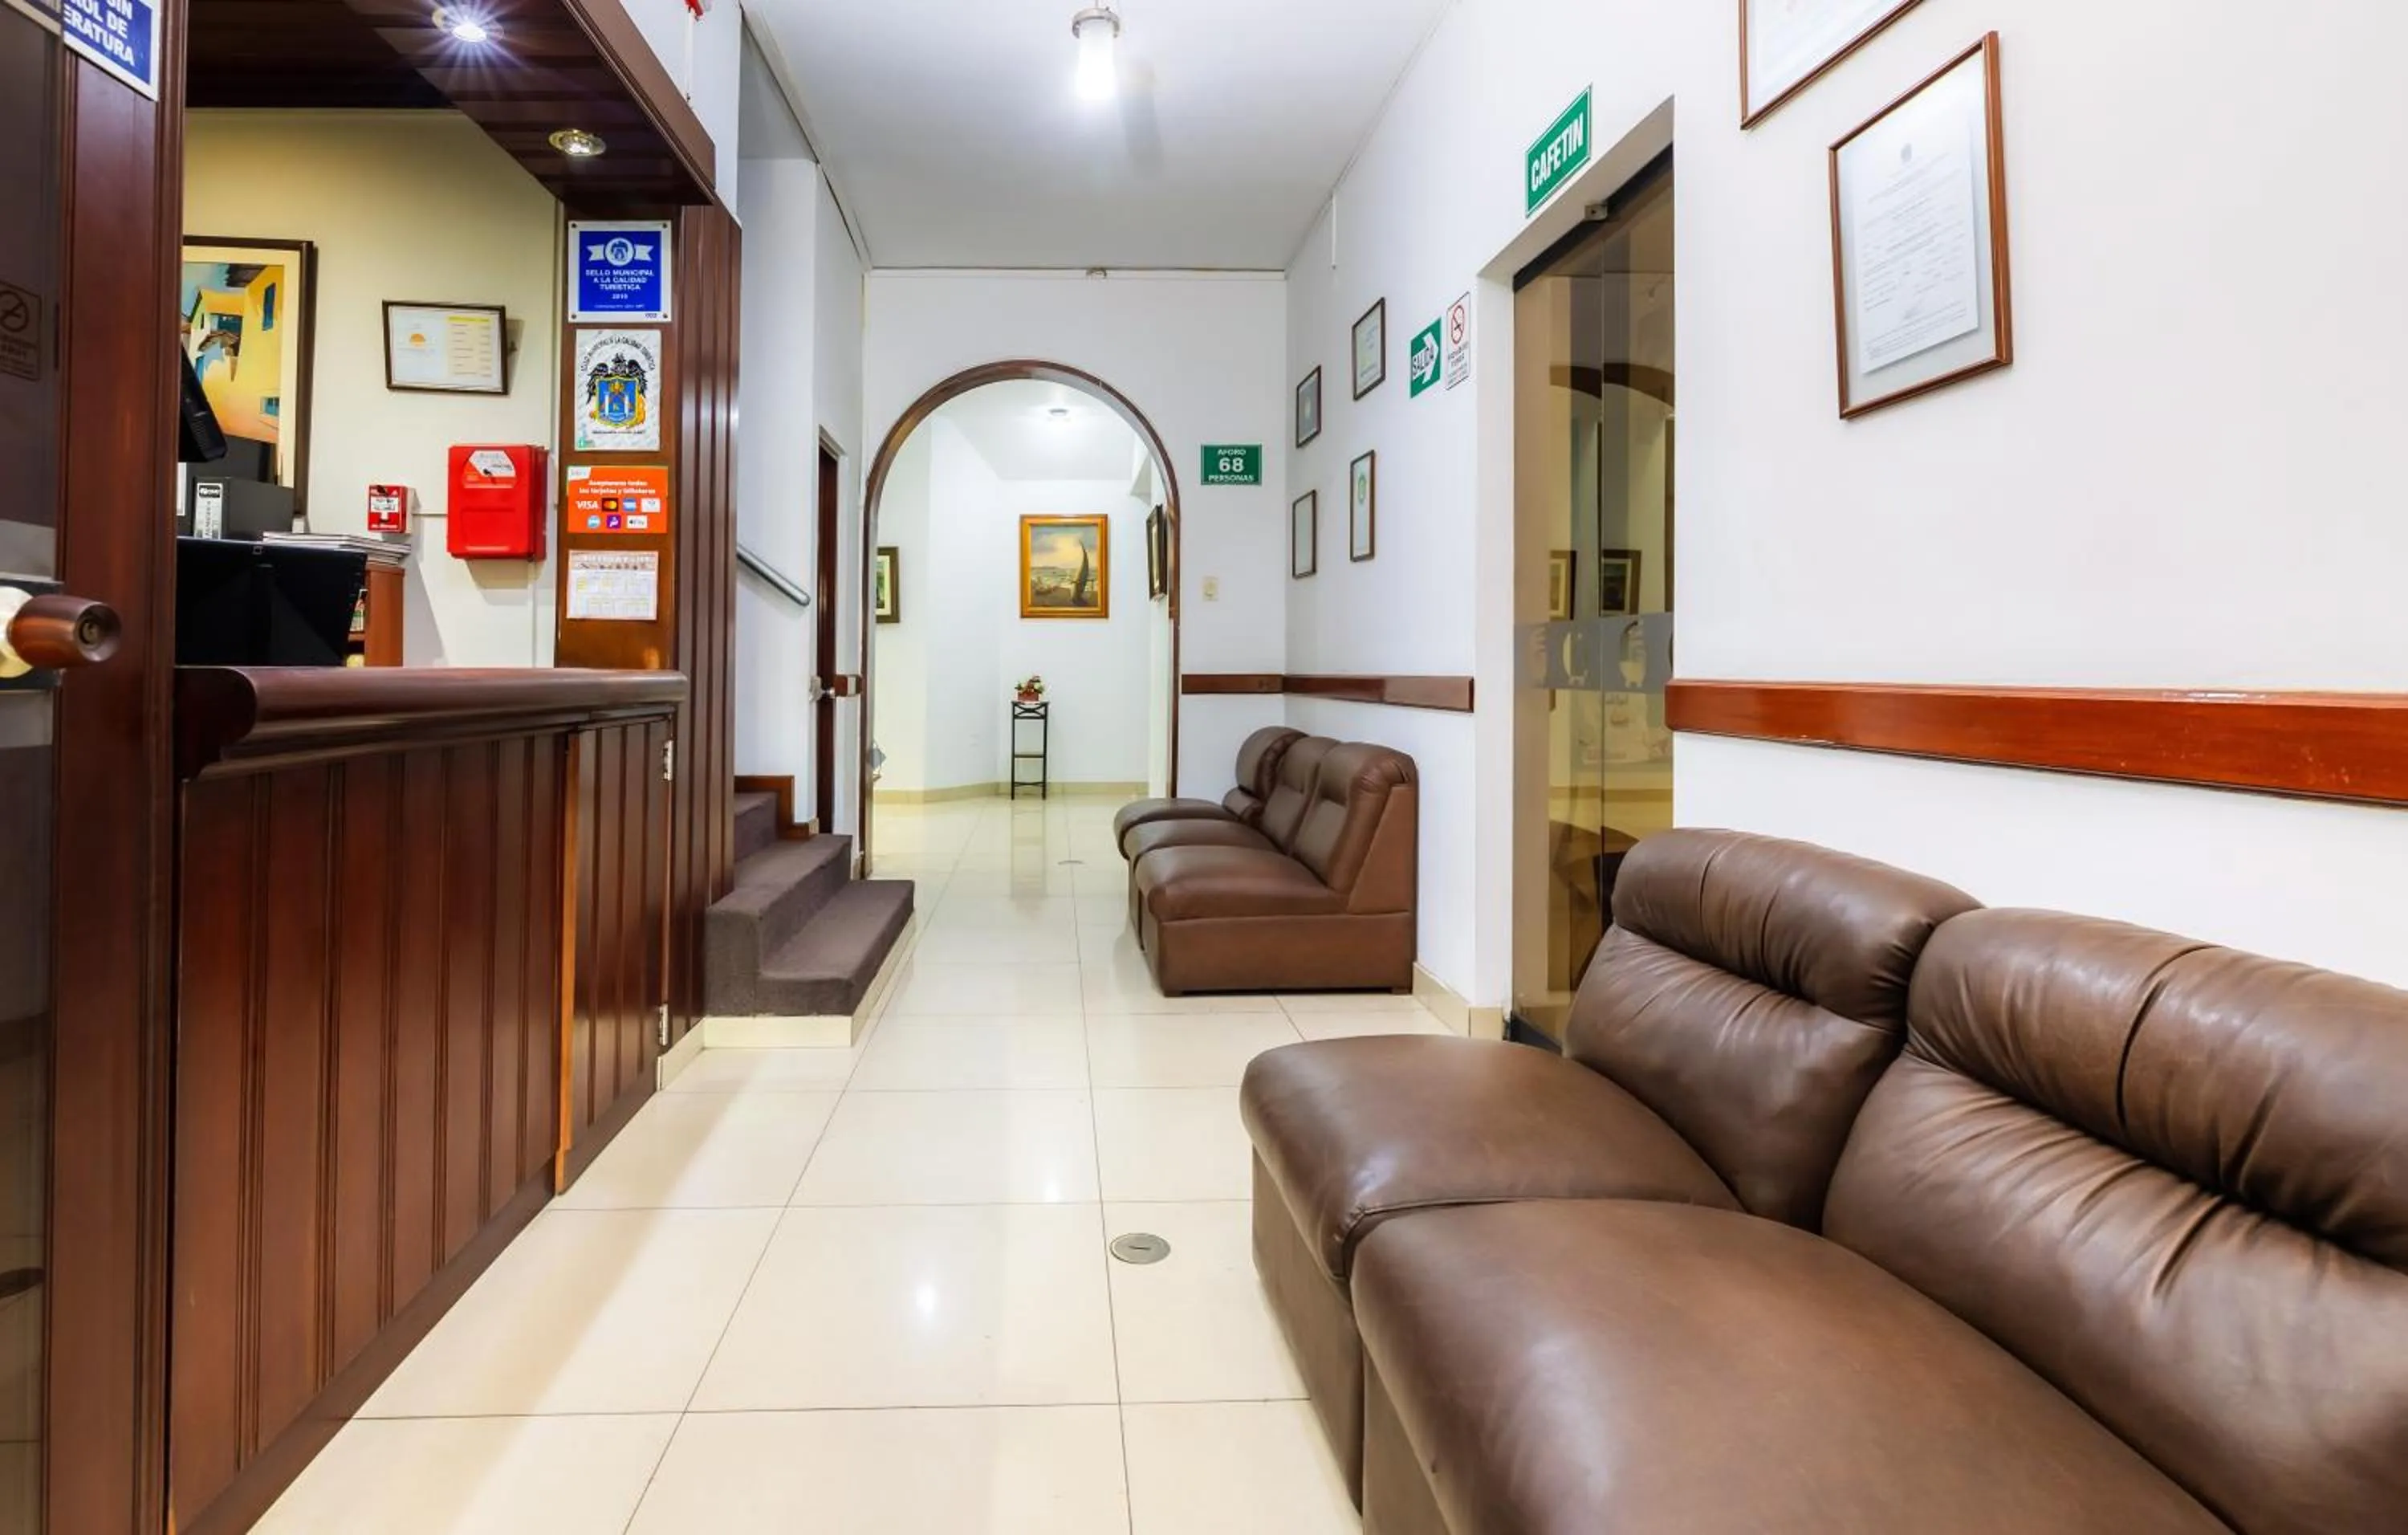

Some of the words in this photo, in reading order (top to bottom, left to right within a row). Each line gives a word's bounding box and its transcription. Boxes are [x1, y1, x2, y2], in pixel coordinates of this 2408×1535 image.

[107, 10, 128, 39] DE
[1531, 112, 1584, 193] CAFETIN
[1218, 457, 1243, 472] 68
[576, 500, 599, 509] VISA
